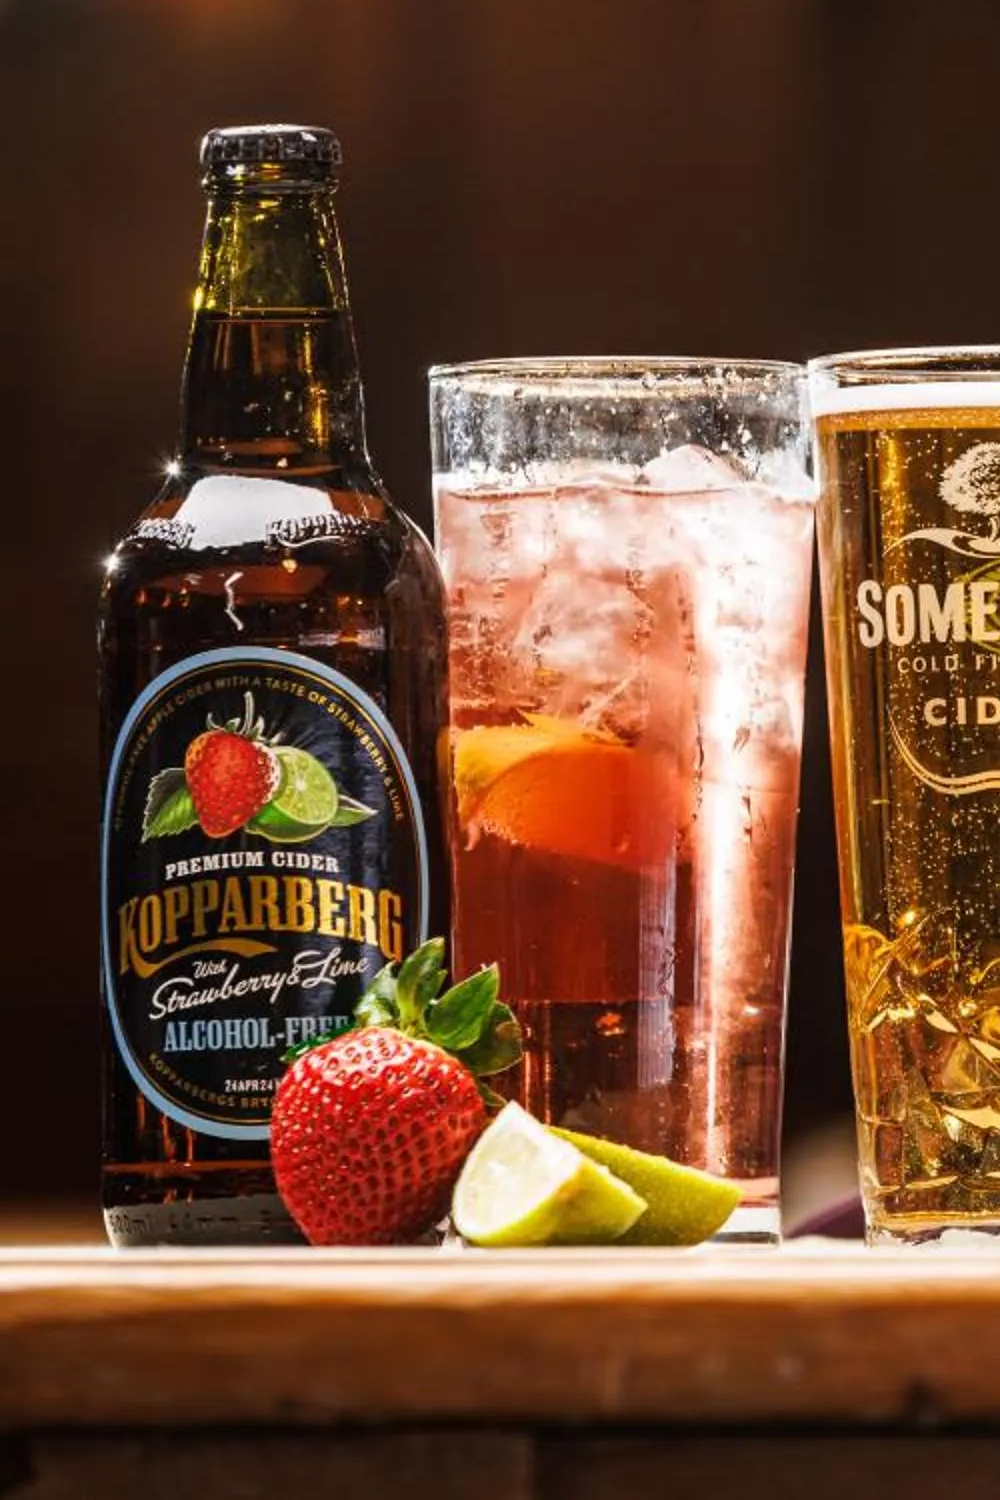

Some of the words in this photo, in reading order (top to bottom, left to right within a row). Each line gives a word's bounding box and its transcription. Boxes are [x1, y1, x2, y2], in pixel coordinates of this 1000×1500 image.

[897, 654, 960, 674] COLD
[215, 675, 249, 689] WITH
[252, 676, 263, 688] A
[265, 677, 305, 698] TASTE
[307, 690, 328, 706] OF
[326, 702, 388, 774] STRAWBERRY
[164, 851, 265, 881] PREMIUM
[270, 851, 341, 874] CIDER
[117, 875, 402, 975] KOPPARBERG
[191, 958, 228, 980] With
